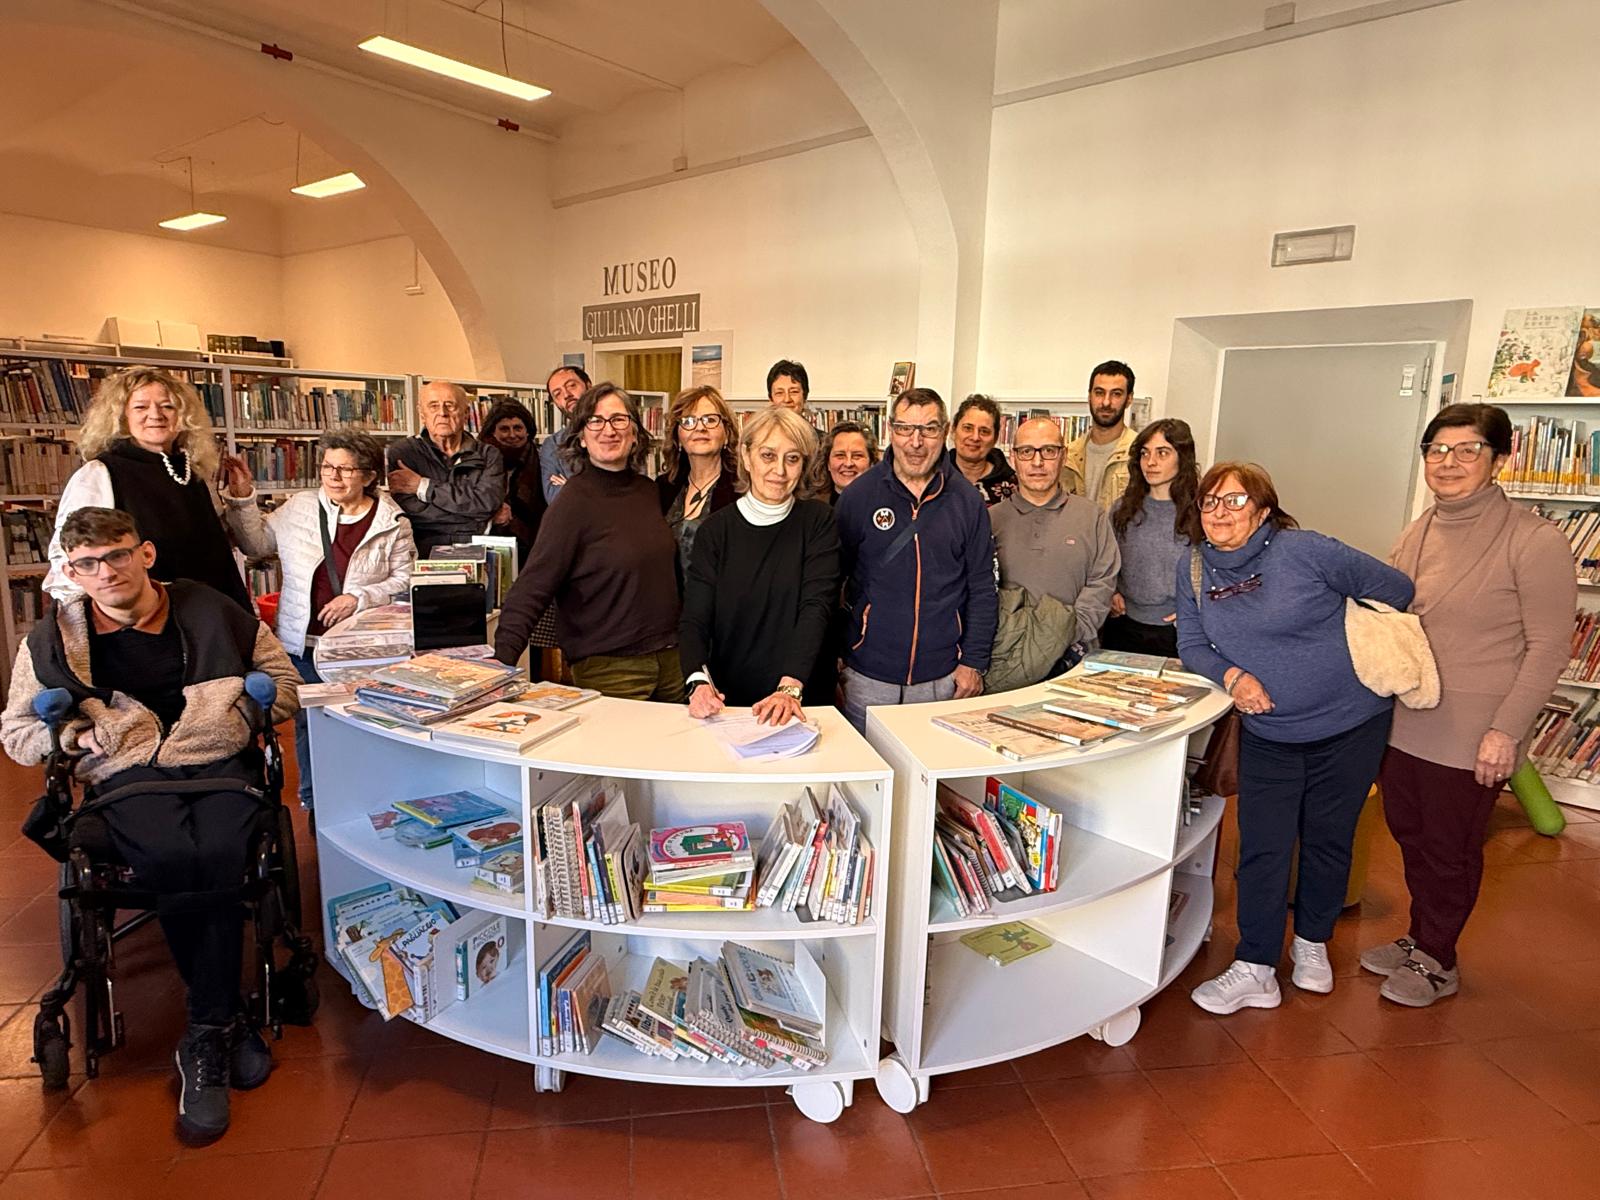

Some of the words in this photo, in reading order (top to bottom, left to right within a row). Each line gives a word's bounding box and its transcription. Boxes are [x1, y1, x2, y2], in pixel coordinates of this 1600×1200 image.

[603, 257, 676, 296] MUSEO
[585, 307, 645, 338] GIULIANO
[648, 301, 697, 334] GHELLI
